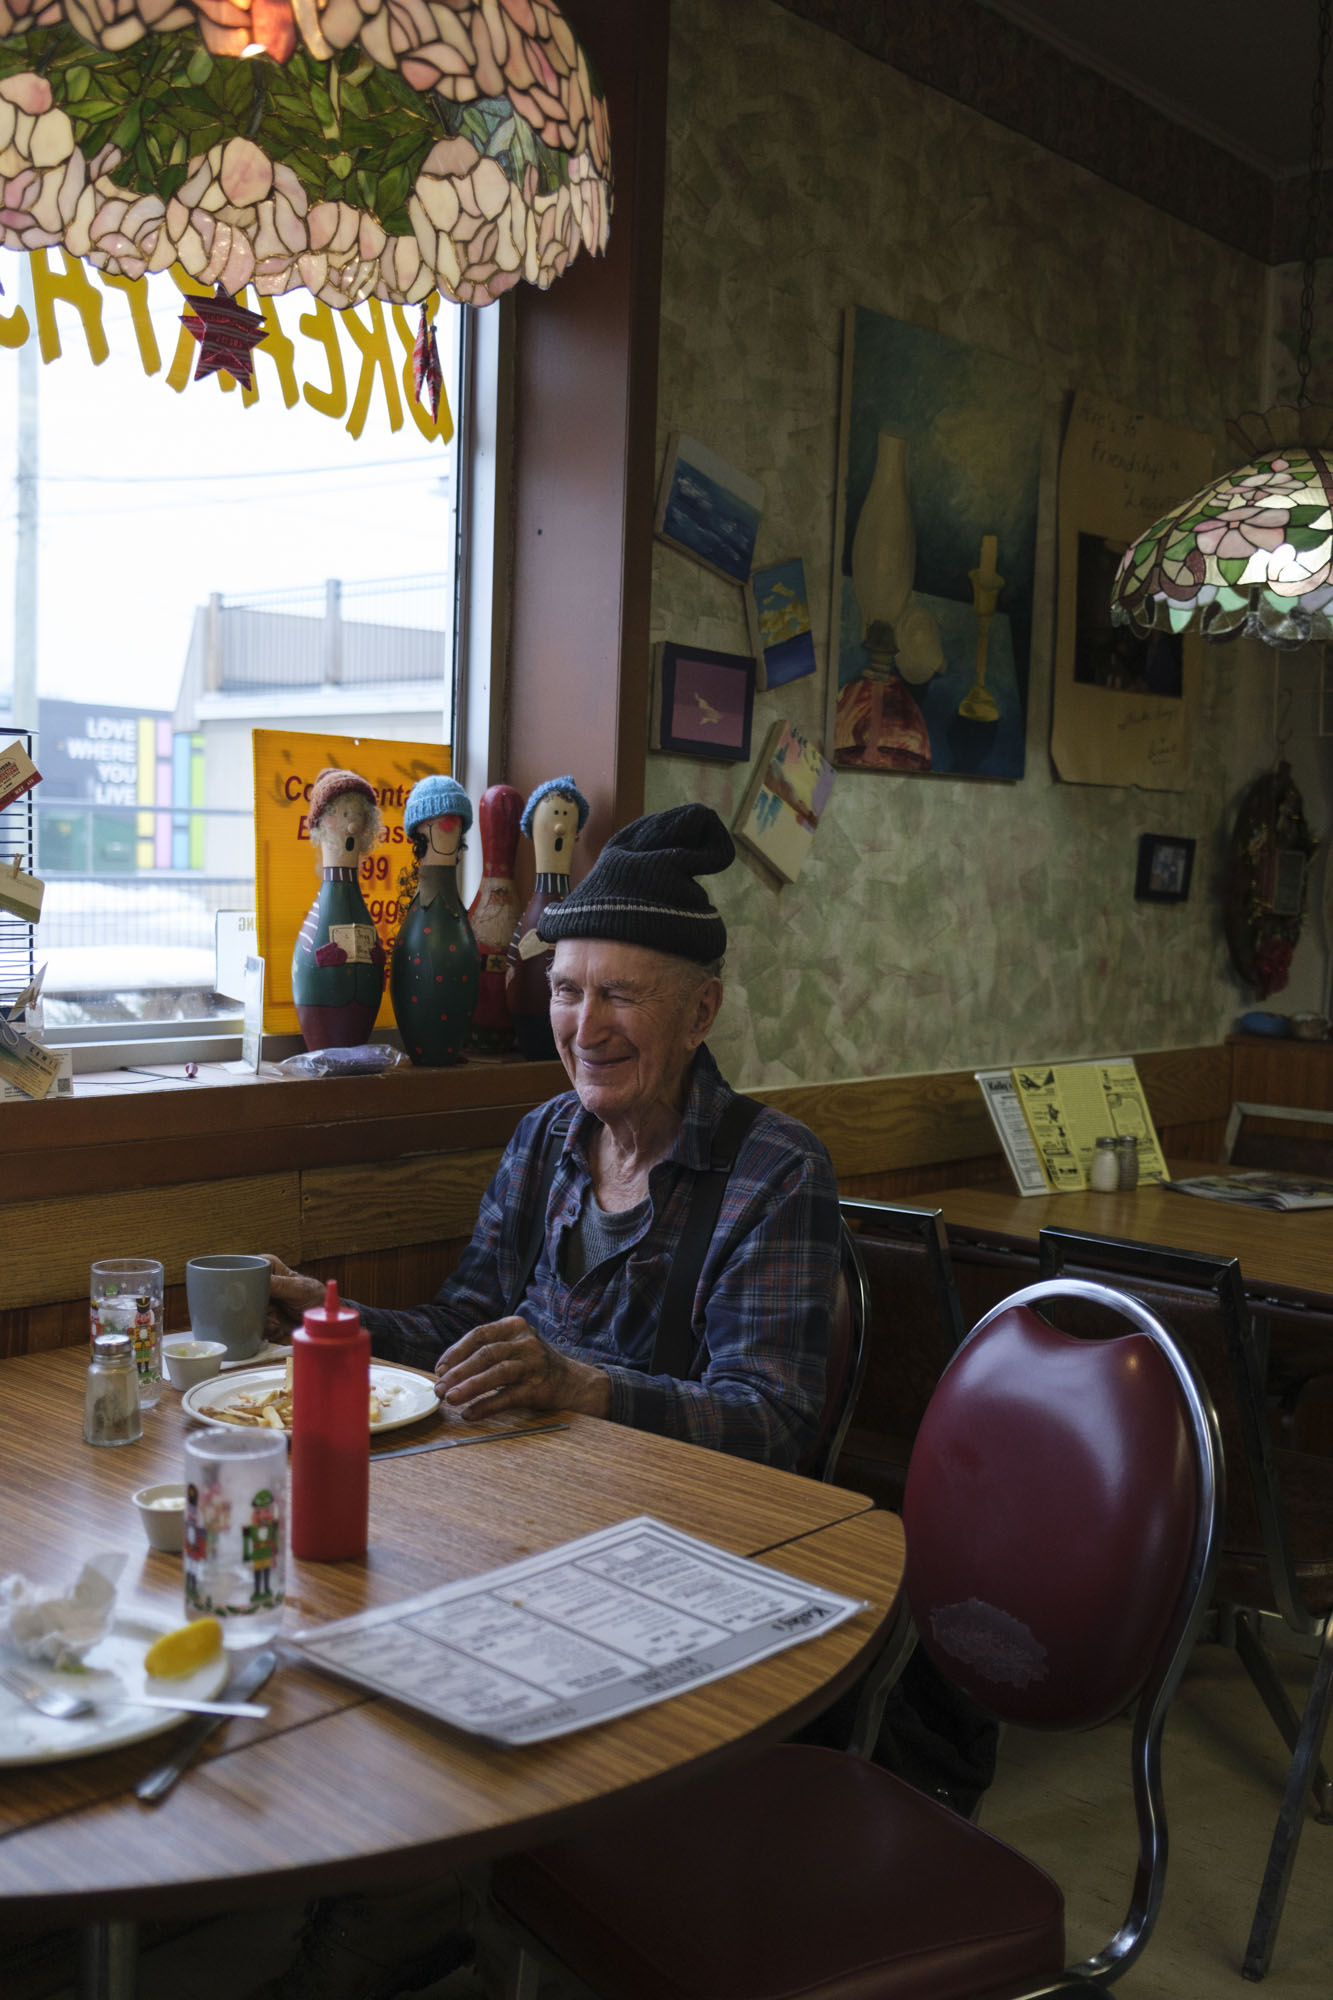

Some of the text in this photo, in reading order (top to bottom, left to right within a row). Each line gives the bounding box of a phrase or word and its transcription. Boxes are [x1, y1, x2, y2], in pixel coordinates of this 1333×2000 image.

[86, 717, 137, 741] LOVE
[67, 738, 137, 763] WHERE
[96, 762, 137, 784] YOU
[96, 782, 137, 805] LIVE
